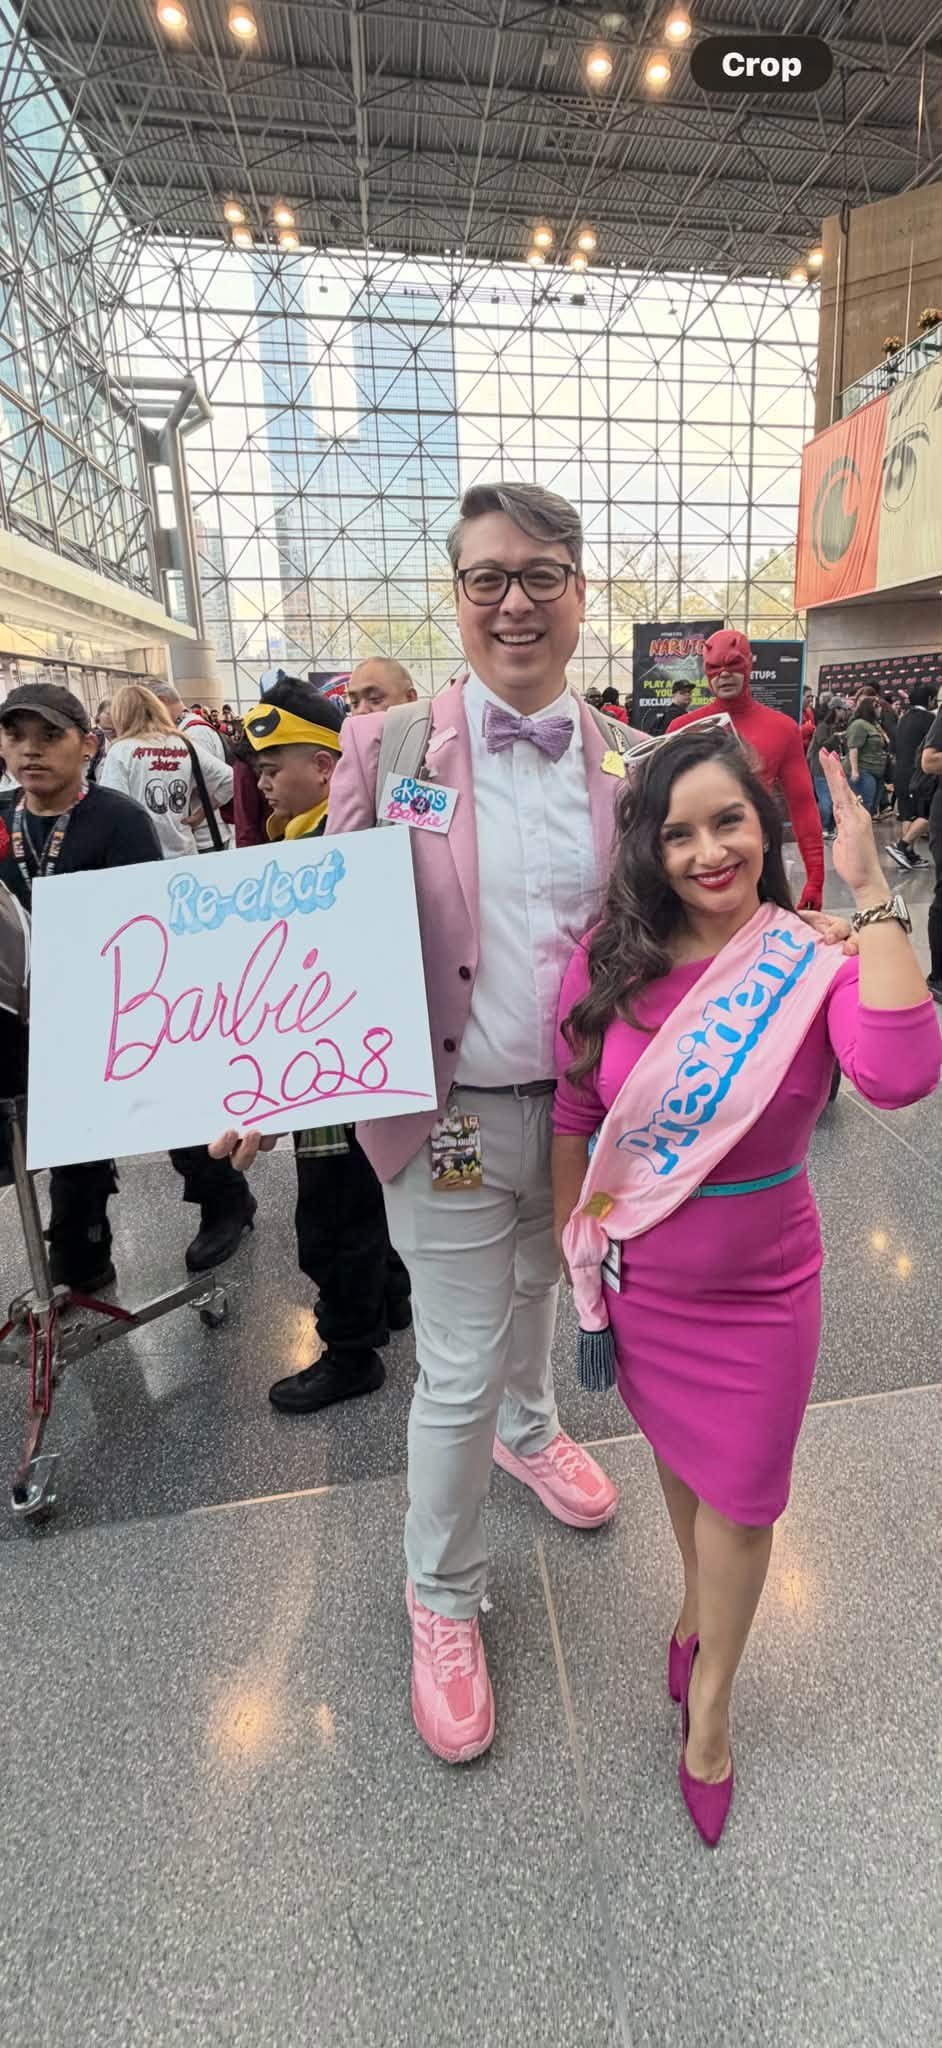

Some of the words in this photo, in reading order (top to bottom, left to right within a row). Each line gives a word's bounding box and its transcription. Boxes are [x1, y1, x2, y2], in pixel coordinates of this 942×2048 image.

[649, 638, 704, 656] NARUTO
[640, 697, 672, 707] EXCLUS
[644, 680, 664, 689] PLAY
[145, 778, 188, 814] 08
[168, 849, 345, 935] Re-elect
[100, 914, 358, 1082] Barbie
[222, 1027, 394, 1116] 2028
[616, 929, 816, 1176] President
